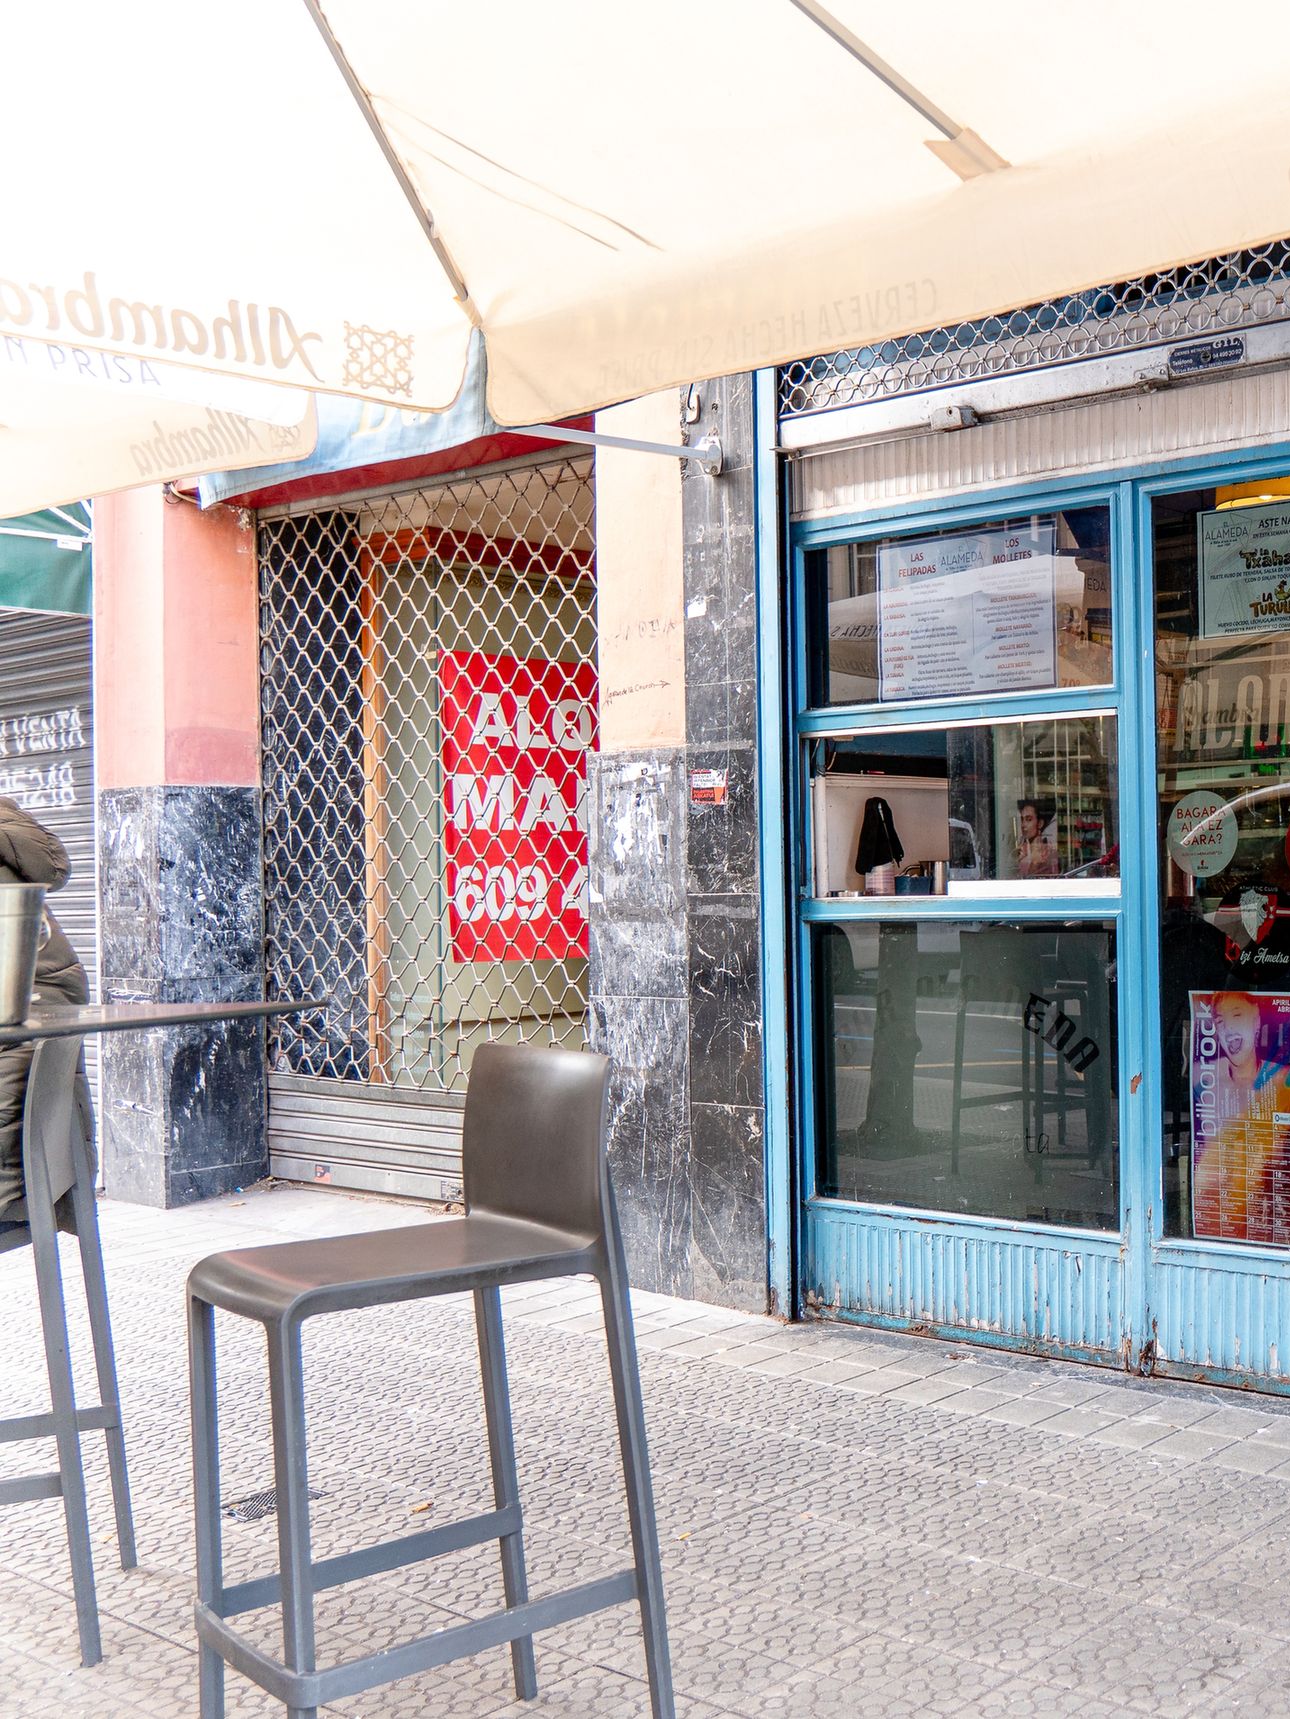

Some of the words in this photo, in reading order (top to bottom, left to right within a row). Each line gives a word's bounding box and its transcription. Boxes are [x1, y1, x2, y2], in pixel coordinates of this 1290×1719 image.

[46, 343, 161, 386] PRISA
[1258, 517, 1279, 529] ASTE
[1205, 526, 1249, 541] ALAMEDA
[1005, 537, 1020, 548] LOS
[910, 552, 924, 562] LAS
[940, 550, 984, 566] ALAMEDA
[992, 550, 1032, 564] MOLLETES
[899, 564, 937, 577] FELIPADAS
[1262, 592, 1273, 602] LA
[453, 864, 549, 922] 609
[1196, 1000, 1216, 1137] bilborock
